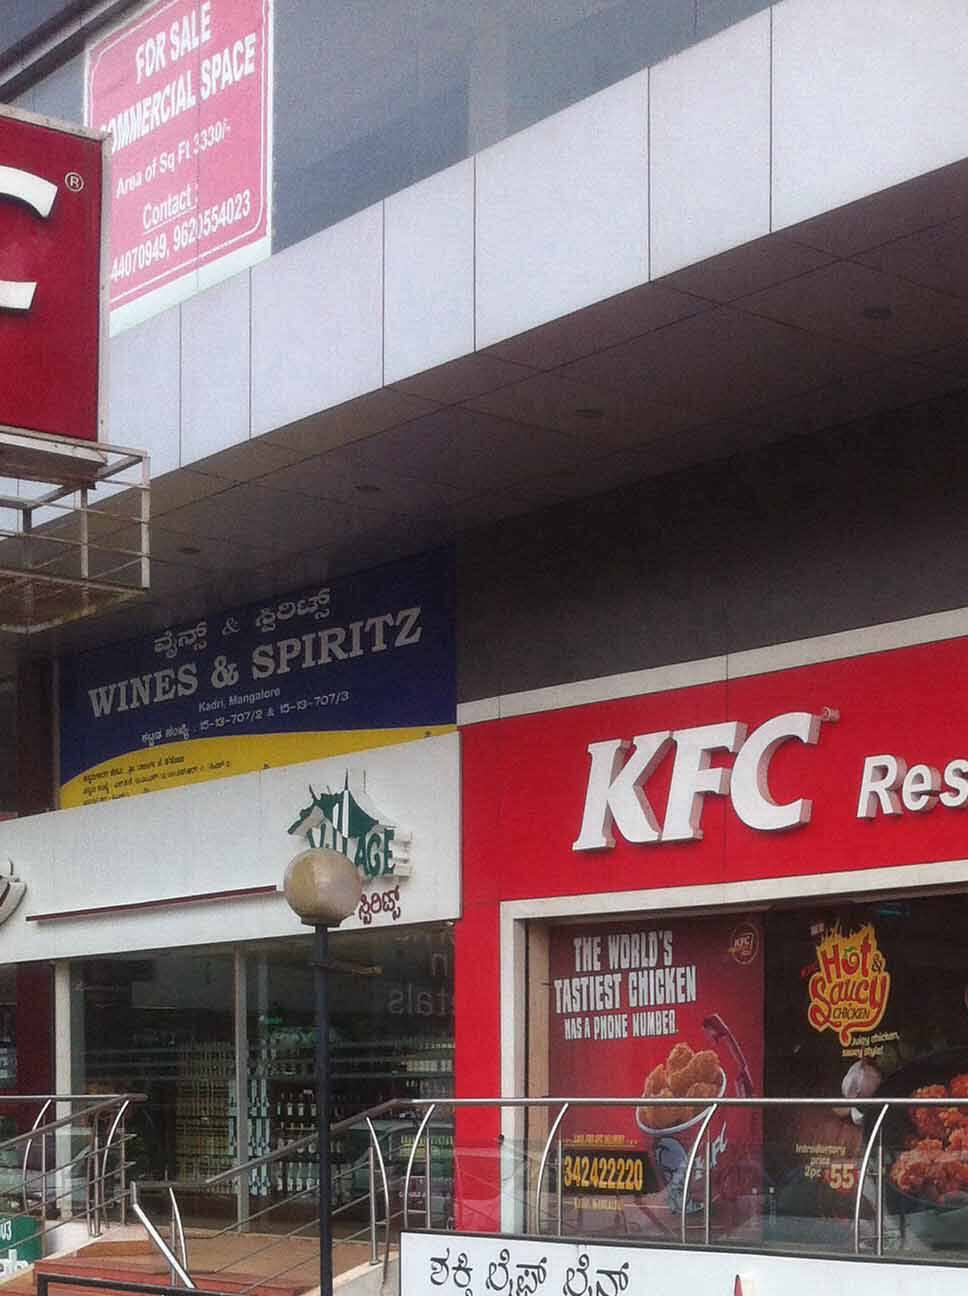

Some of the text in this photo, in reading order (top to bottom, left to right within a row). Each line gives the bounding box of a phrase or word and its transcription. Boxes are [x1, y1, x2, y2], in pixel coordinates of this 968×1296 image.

[136, 1, 212, 84] FOR SALE
[101, 32, 257, 152] OMMERCIAL SPACE
[116, 170, 142, 199] Area
[145, 160, 158, 183] of
[159, 153, 175, 175] Sq
[222, 616, 240, 636] &
[88, 606, 423, 718] WINES & SPIRITZ
[229, 686, 282, 708] Mangalore
[571, 711, 822, 852] KFC
[573, 930, 673, 972] THE WORLD'S
[820, 935, 871, 983] Hot
[554, 965, 697, 1014] TASTIEST CHICKEN
[809, 974, 889, 1033] Saucy
[565, 1018, 582, 1040] HAS
[584, 1017, 591, 1038] A
[593, 1014, 628, 1040] PHONE
[832, 1007, 870, 1019] CHICKEN
[564, 1155, 643, 1192] 342422220
[830, 1163, 854, 1189] 55
